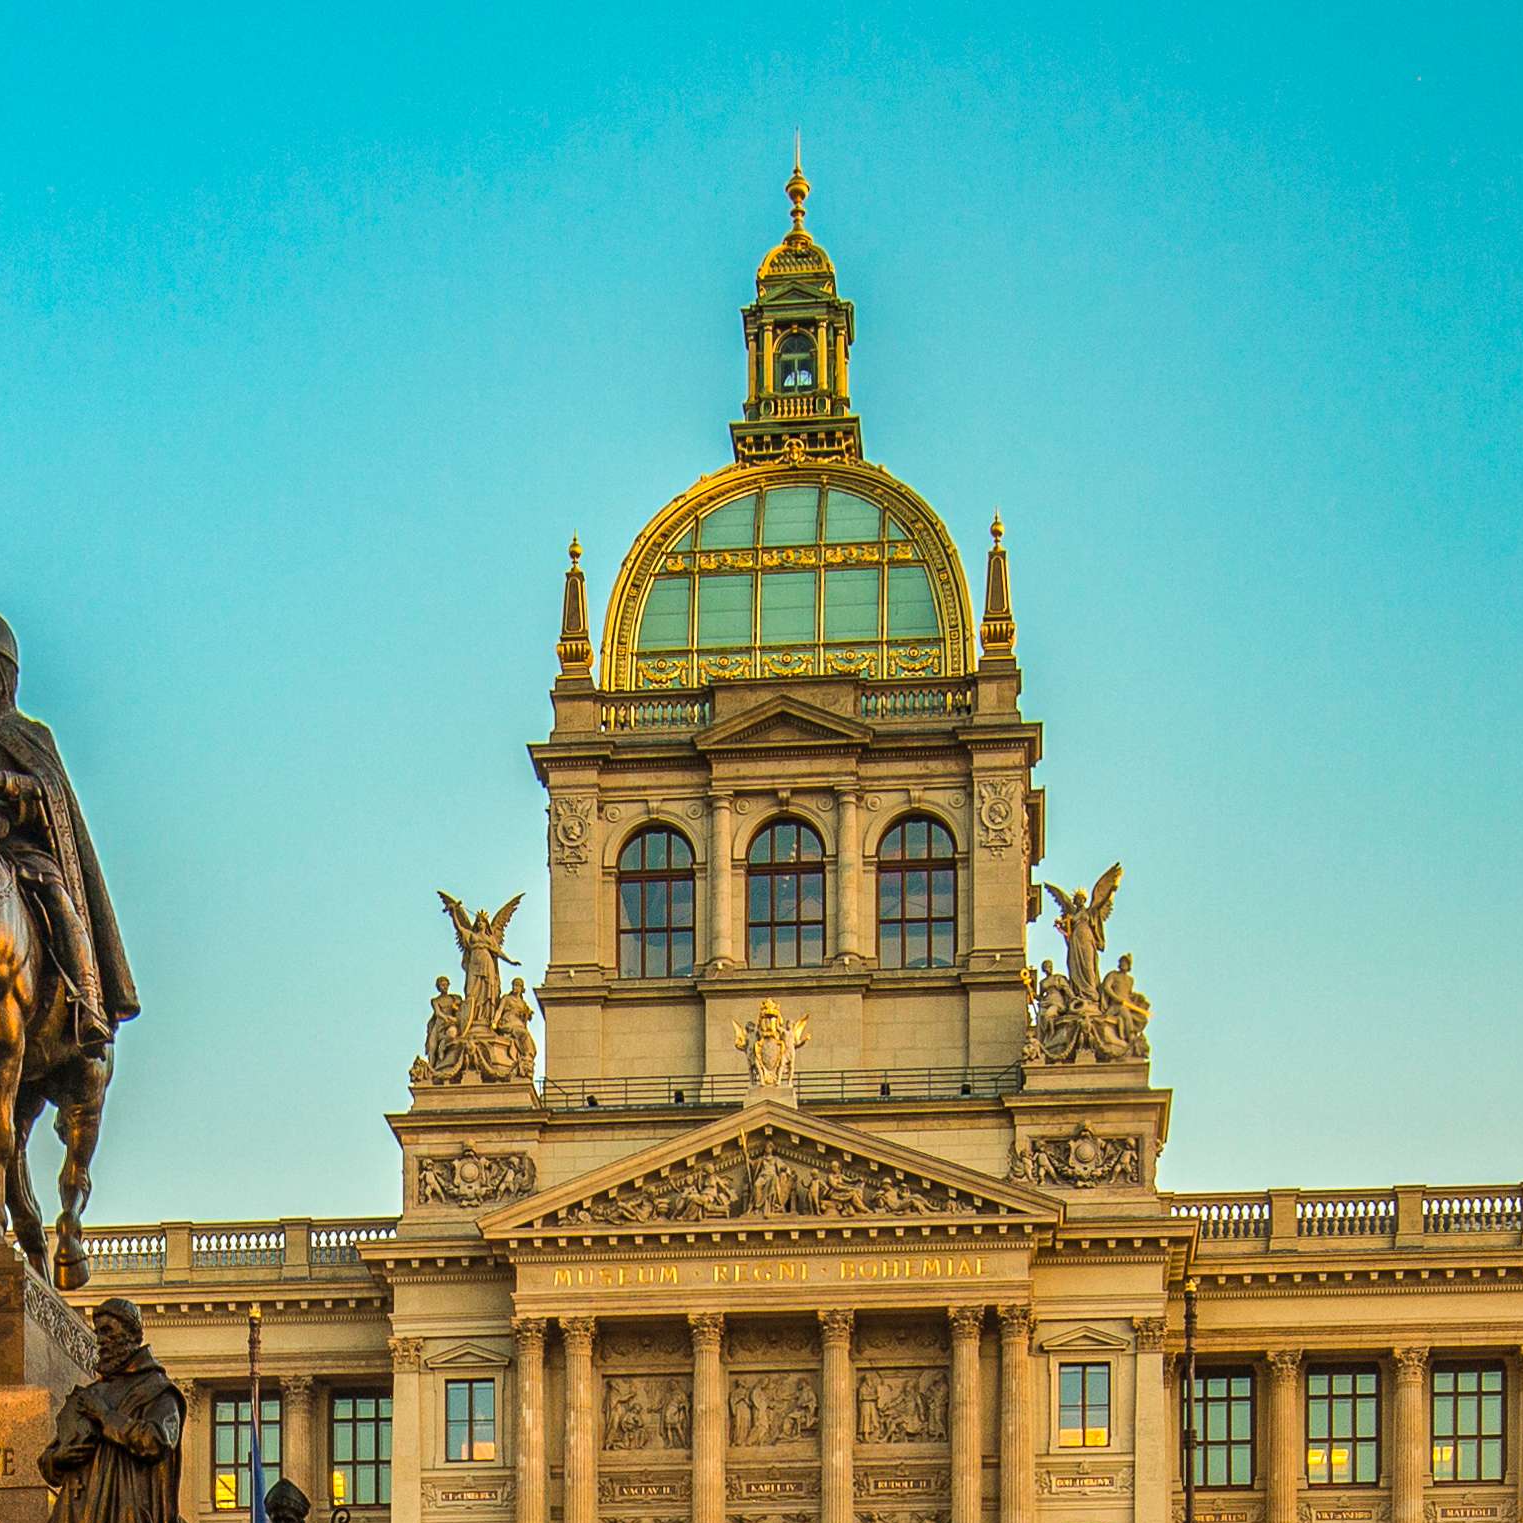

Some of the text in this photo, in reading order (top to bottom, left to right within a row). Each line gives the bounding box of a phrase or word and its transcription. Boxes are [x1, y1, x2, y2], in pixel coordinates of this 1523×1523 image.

[553, 1256, 990, 1287] MUSEUM REGNI BOHEMIAE
[1446, 1508, 1491, 1518] MATTIOLI
